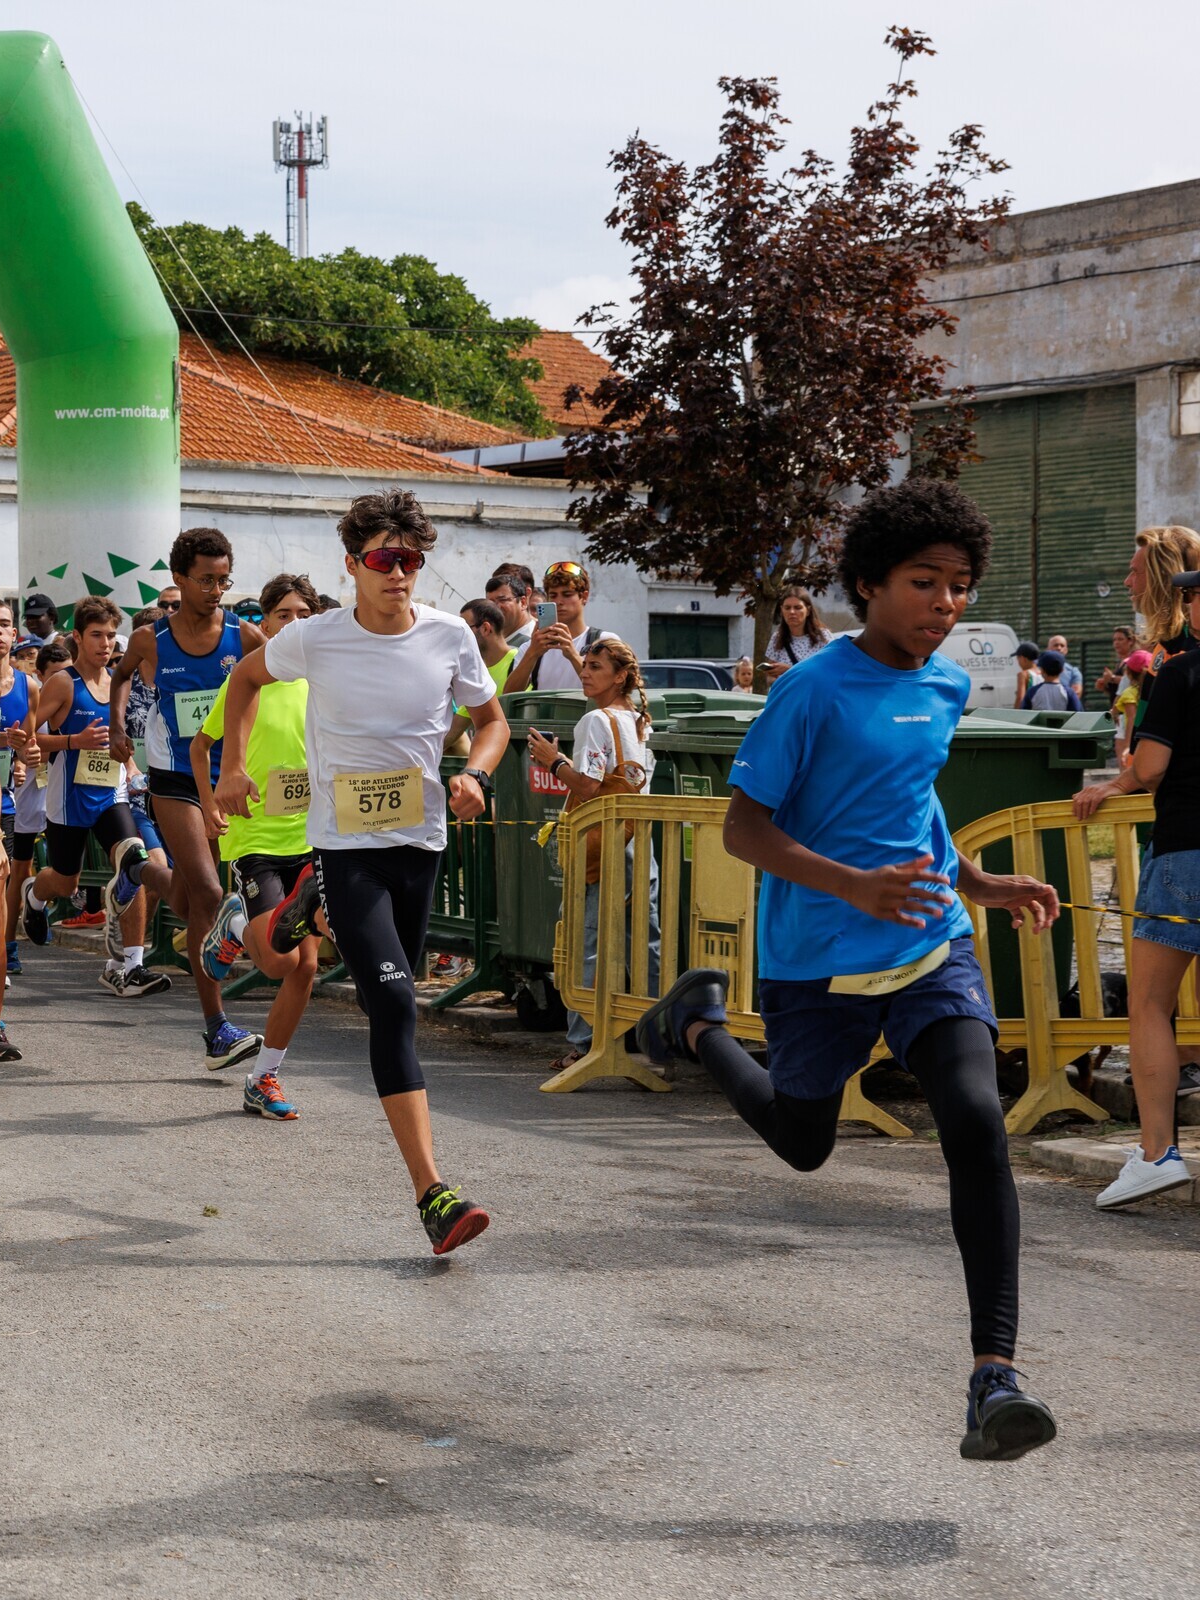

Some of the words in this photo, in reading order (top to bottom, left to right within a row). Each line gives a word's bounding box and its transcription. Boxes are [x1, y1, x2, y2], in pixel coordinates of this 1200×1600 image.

[54, 404, 170, 421] www.cm-moita.pt
[88, 760, 110, 773] 684
[372, 774, 409, 785] ATLETISMO
[377, 781, 405, 791] VEDROS
[284, 783, 311, 799] 692
[359, 790, 402, 813] 578
[362, 817, 401, 826] ATLETISMOITA
[379, 970, 407, 983] ONDA
[866, 968, 918, 986] ATLETISMOITA
